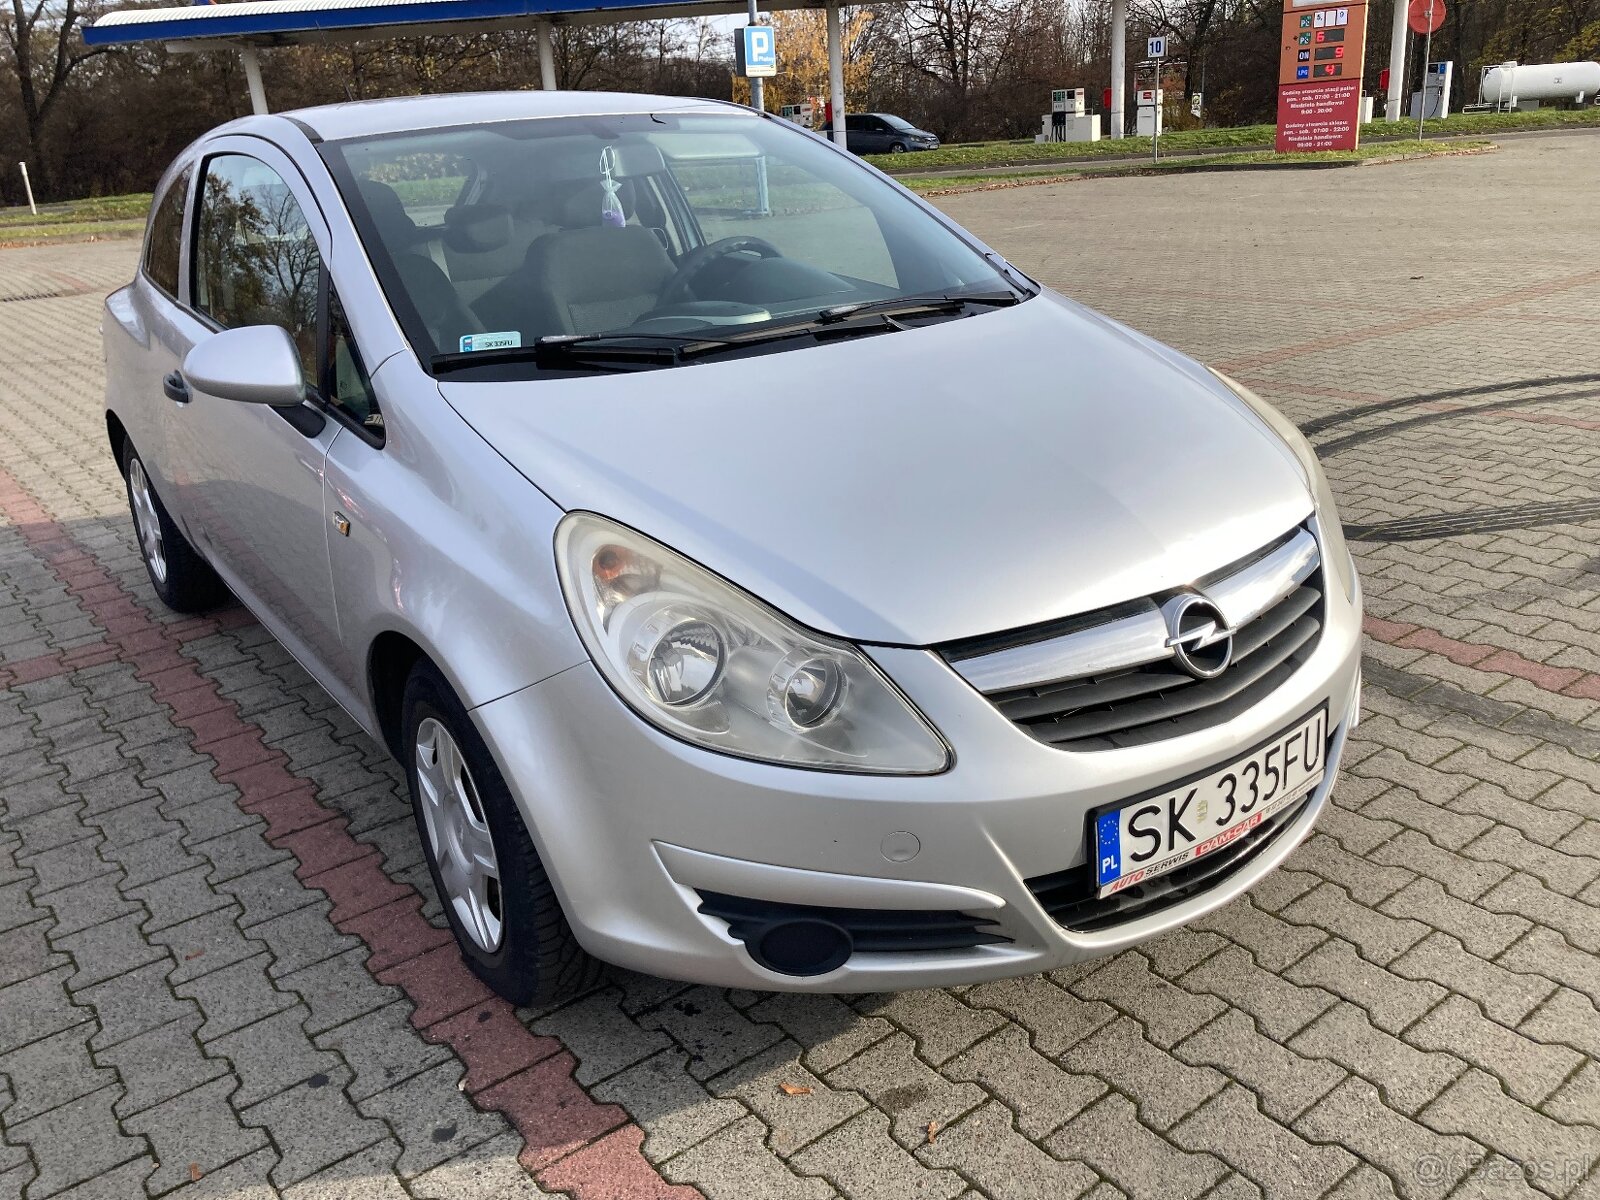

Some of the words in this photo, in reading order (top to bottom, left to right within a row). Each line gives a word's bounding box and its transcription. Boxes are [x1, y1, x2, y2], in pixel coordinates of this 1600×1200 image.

[751, 32, 769, 62] P
[1150, 41, 1161, 53] 10
[1317, 31, 1325, 42] 6
[1102, 854, 1118, 874] PL
[1128, 788, 1198, 863] SK
[1215, 718, 1320, 826] 335FU
[1109, 870, 1145, 892] AUTO
[1145, 851, 1190, 876] SERWIS
[1200, 814, 1260, 852] DAM-CAR
